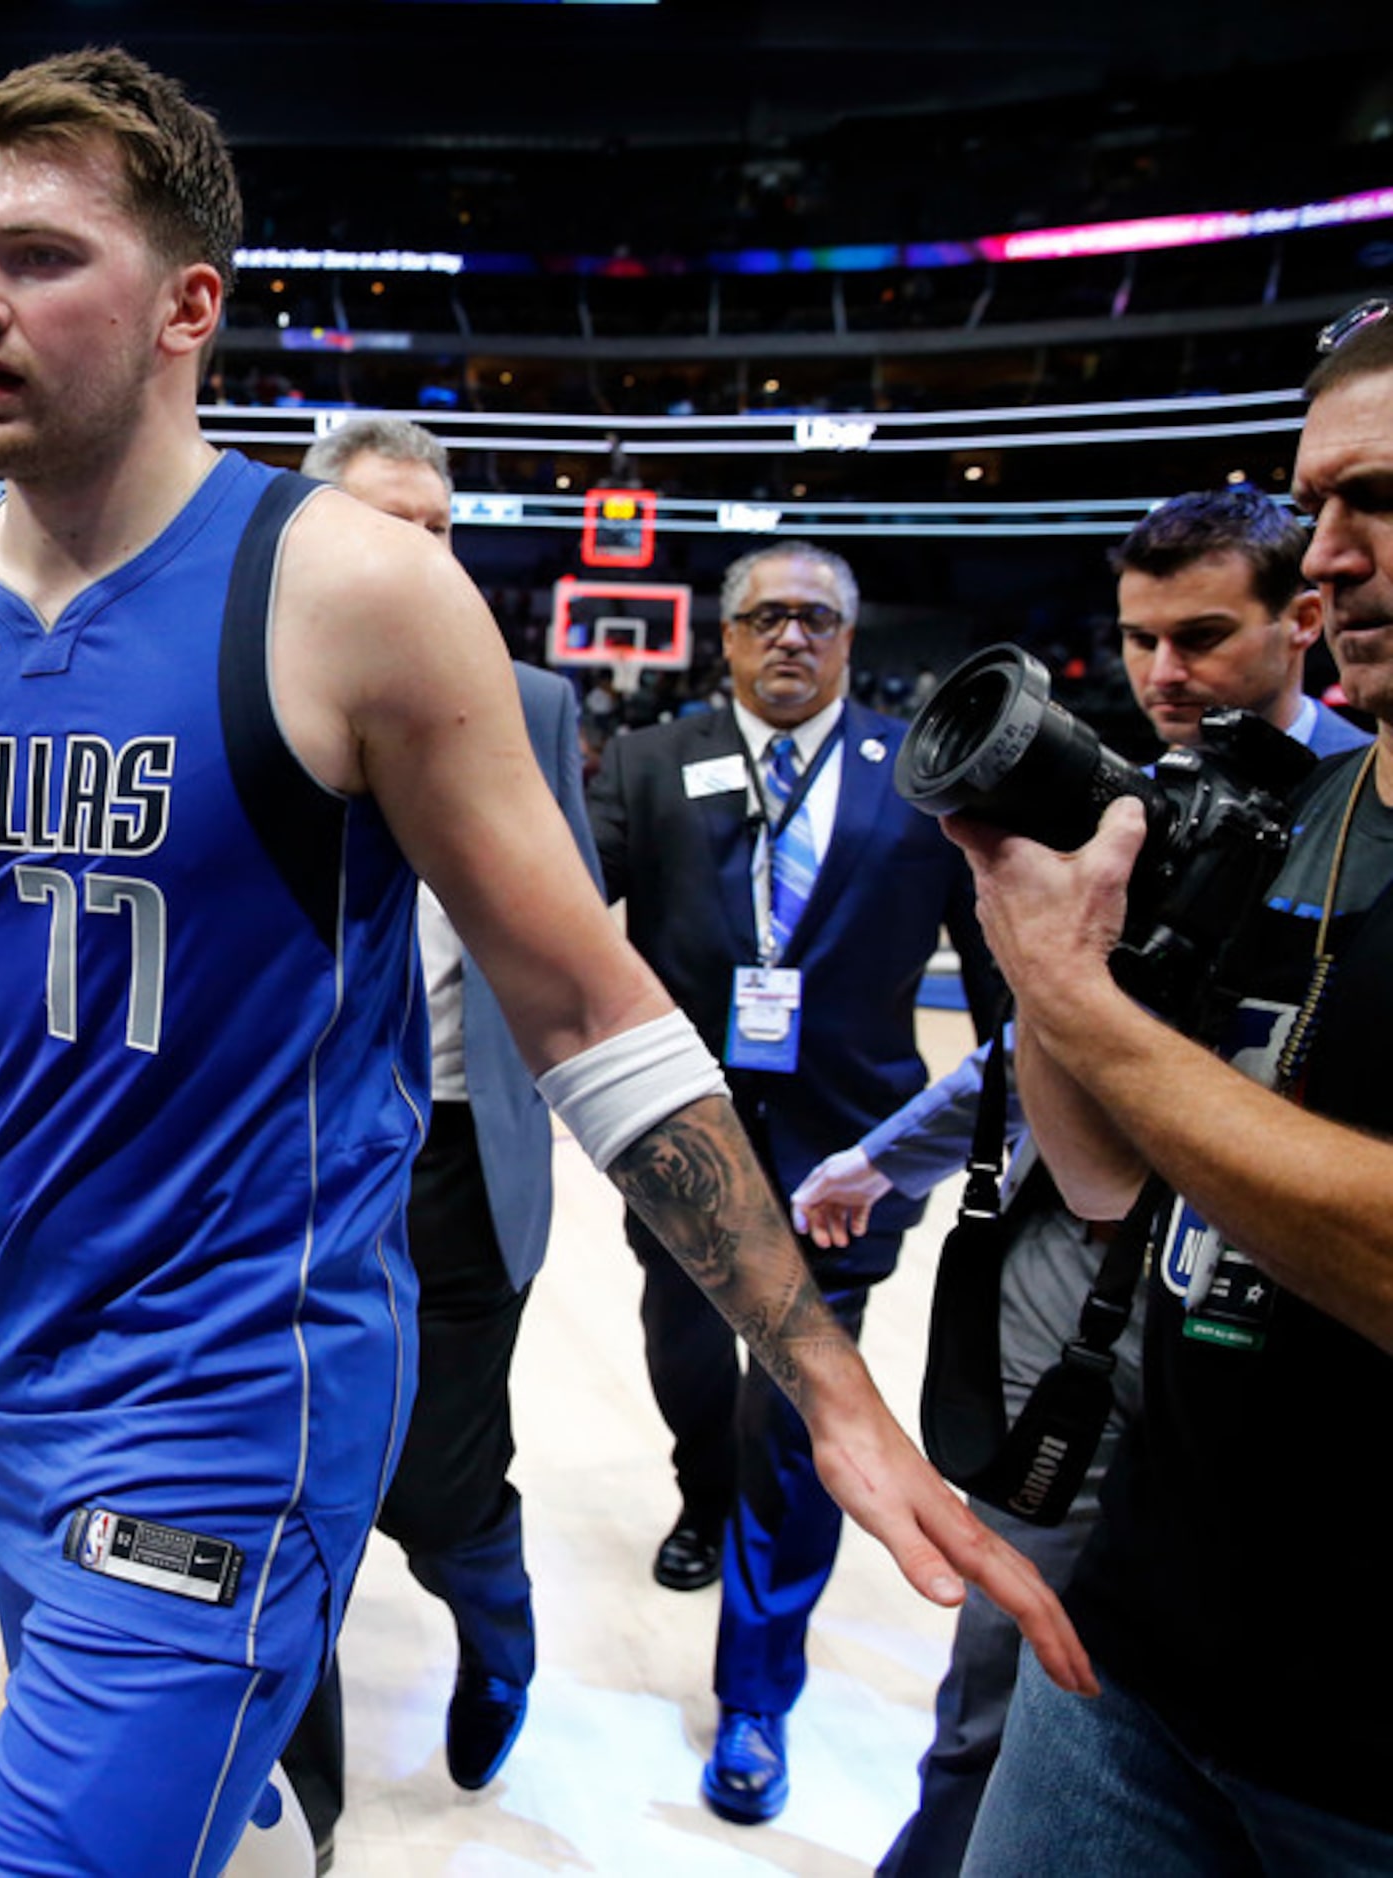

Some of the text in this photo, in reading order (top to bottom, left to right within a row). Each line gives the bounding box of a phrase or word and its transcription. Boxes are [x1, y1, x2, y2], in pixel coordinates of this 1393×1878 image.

[795, 417, 875, 450] Uber
[718, 503, 781, 531] Uber
[14, 865, 167, 1054] 77
[1007, 1435, 1068, 1515] Canon
